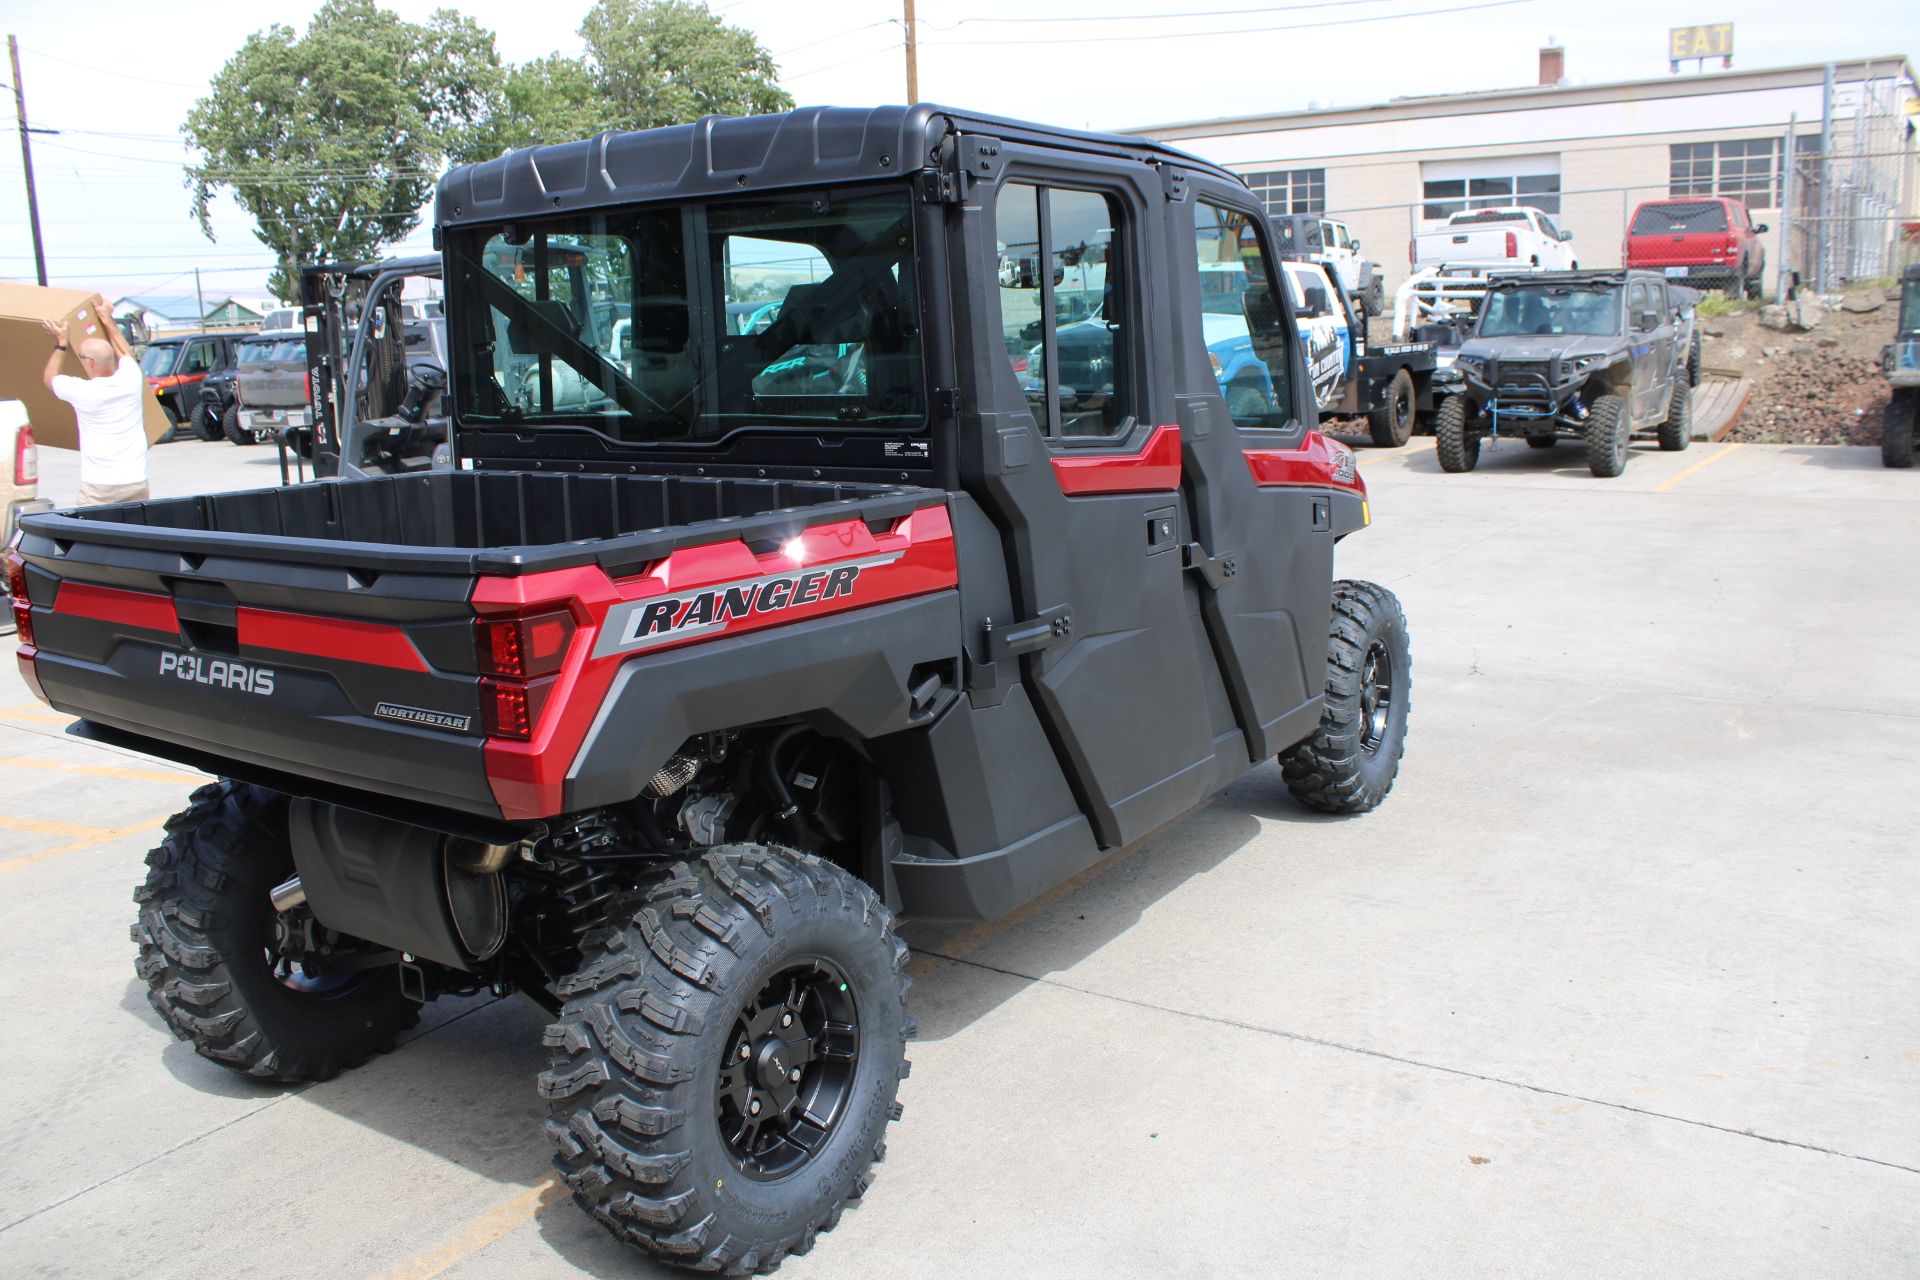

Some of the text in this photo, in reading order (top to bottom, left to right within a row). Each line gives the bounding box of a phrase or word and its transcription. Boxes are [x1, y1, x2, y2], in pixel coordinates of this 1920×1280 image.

[1672, 25, 1731, 57] EAT
[759, 356, 807, 377] RZR
[311, 366, 324, 419] TOYOTA
[1329, 448, 1355, 468] XP
[1335, 469, 1355, 480] 1000
[633, 565, 860, 639] RANGER
[159, 651, 275, 696] POLARIS
[378, 705, 465, 728] NORTHSTAR
